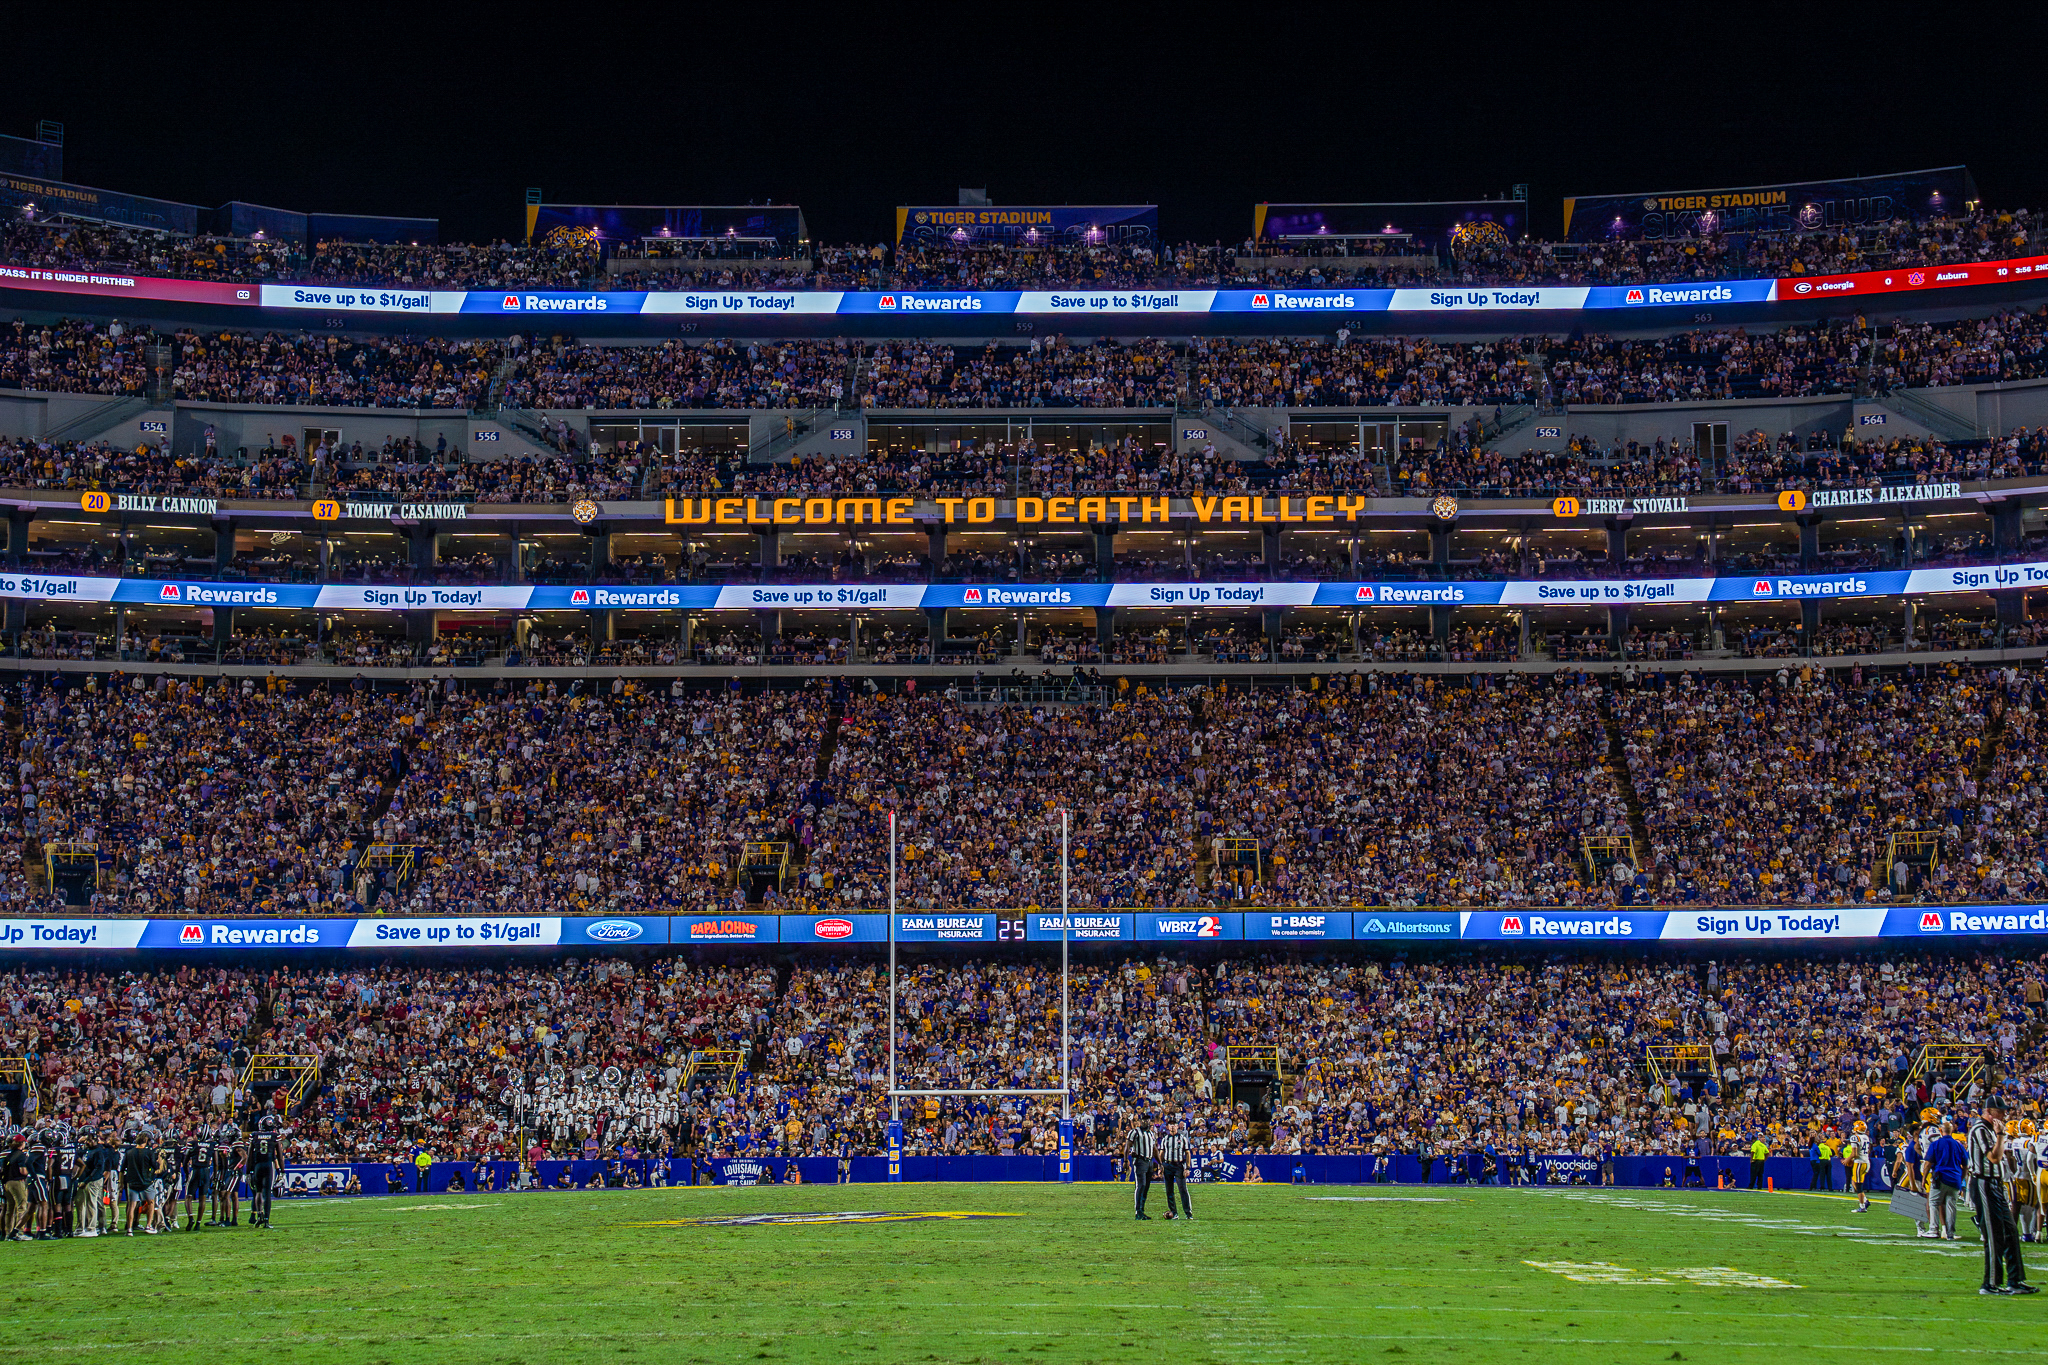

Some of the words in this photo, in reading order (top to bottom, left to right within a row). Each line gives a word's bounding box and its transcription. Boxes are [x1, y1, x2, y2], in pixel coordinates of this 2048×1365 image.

[9, 179, 42, 194] TIGER
[46, 186, 97, 203] STADIUM
[1658, 197, 1707, 210] TIGER
[1711, 191, 1786, 207] STADIUM
[930, 212, 975, 224] TIGER
[980, 212, 1050, 224] STADIUM
[1641, 205, 1791, 238] SKYLINE
[1800, 196, 1893, 229] CLUB
[1064, 225, 1150, 248] CLUB
[0, 268, 29, 278] PASS.
[31, 271, 41, 279] IT
[43, 272, 52, 280] IS
[55, 273, 88, 283] UNDER
[91, 276, 134, 286] FURTHER
[1822, 281, 1854, 290] Georgia
[238, 290, 250, 298] CC
[294, 290, 331, 303] Save
[336, 294, 356, 308] up
[360, 294, 375, 305] to
[380, 293, 428, 309] $1/gal!
[1051, 296, 1085, 307] Save
[1090, 298, 1108, 309] up
[1113, 296, 1127, 307] to
[1131, 294, 1178, 309] $1/gal!
[1275, 294, 1354, 308] Rewards
[1431, 293, 1462, 307] Sign
[1468, 293, 1488, 306] Up
[1492, 292, 1539, 306] Today!
[1649, 286, 1732, 303] Rewards
[526, 296, 606, 310] Rewards
[686, 296, 717, 310] Sign
[723, 296, 743, 310] Up
[747, 296, 794, 310] Today!
[902, 296, 981, 309] Rewards
[327, 319, 344, 327] 555
[1694, 313, 1712, 322] 563
[1016, 323, 1033, 331] 559
[144, 422, 166, 432] 554
[1864, 415, 1882, 425] 564
[478, 432, 497, 441] 556
[834, 431, 851, 439] 558
[1187, 430, 1204, 439] 560
[1540, 428, 1557, 437] 562
[88, 494, 104, 510] 20
[1788, 493, 1796, 508] 4
[1813, 489, 1873, 507] CHARLES
[1880, 482, 1960, 503] ALEXANDER
[118, 495, 156, 511] BILLY
[162, 497, 217, 514] CANNON
[318, 502, 334, 517] 37
[346, 503, 392, 518] TOMMY
[401, 504, 466, 519] CASANOVA
[664, 498, 914, 524] WELCOME
[935, 497, 995, 524] TO
[1016, 497, 1170, 523] DEATH
[1190, 496, 1366, 522] VALLEY
[1558, 500, 1574, 515] 21
[1586, 498, 1626, 514] JERRY
[1633, 498, 1688, 513] STOVALL
[1953, 572, 1989, 587] Sign
[1994, 568, 2019, 585] Up
[21, 578, 76, 596] $1/gal!
[1380, 586, 1464, 601] Rewards
[1539, 586, 1575, 598] Save
[1581, 588, 1599, 600] up
[1604, 586, 1619, 597] to
[1624, 584, 1674, 599] $1/gal!
[1778, 578, 1866, 595] Rewards
[187, 586, 277, 603] Rewards
[364, 590, 398, 605] Sign
[405, 590, 428, 606] Up
[432, 591, 481, 605] Today!
[595, 590, 679, 604] Rewards
[753, 590, 789, 602] Save
[794, 592, 813, 605] up
[818, 590, 832, 602] to
[837, 588, 886, 604] $1/gal!
[988, 588, 1071, 603] Rewards
[1151, 588, 1183, 603] Sign
[1189, 588, 1210, 602] Up
[1215, 587, 1263, 602] Today!
[817, 925, 850, 933] Community
[902, 918, 934, 928] FARM
[937, 918, 983, 928] BUREAU
[1075, 917, 1120, 928] BUREAU
[1158, 921, 1196, 932] WBRZ
[1198, 916, 1213, 936] 2
[1290, 916, 1325, 927] BASF
[1387, 921, 1450, 933] Albertsons
[1530, 917, 1632, 935] Rewards
[1697, 917, 1738, 935] Sign
[1746, 916, 1771, 934] Up
[1778, 915, 1839, 933] Today!
[31, 925, 96, 944] Today!
[212, 925, 319, 943] Rewards
[376, 925, 420, 939] Save
[427, 928, 450, 942] up
[456, 925, 474, 938] to
[480, 922, 540, 941] $1/gal!
[598, 924, 632, 937] Ford
[999, 920, 1024, 939] 25
[61, 1154, 75, 1170] 27
[889, 1137, 899, 1174] LSU
[1060, 1136, 1070, 1173] LSU
[723, 1164, 762, 1176] LOUISIANA
[1544, 1160, 1597, 1170] Woodside
